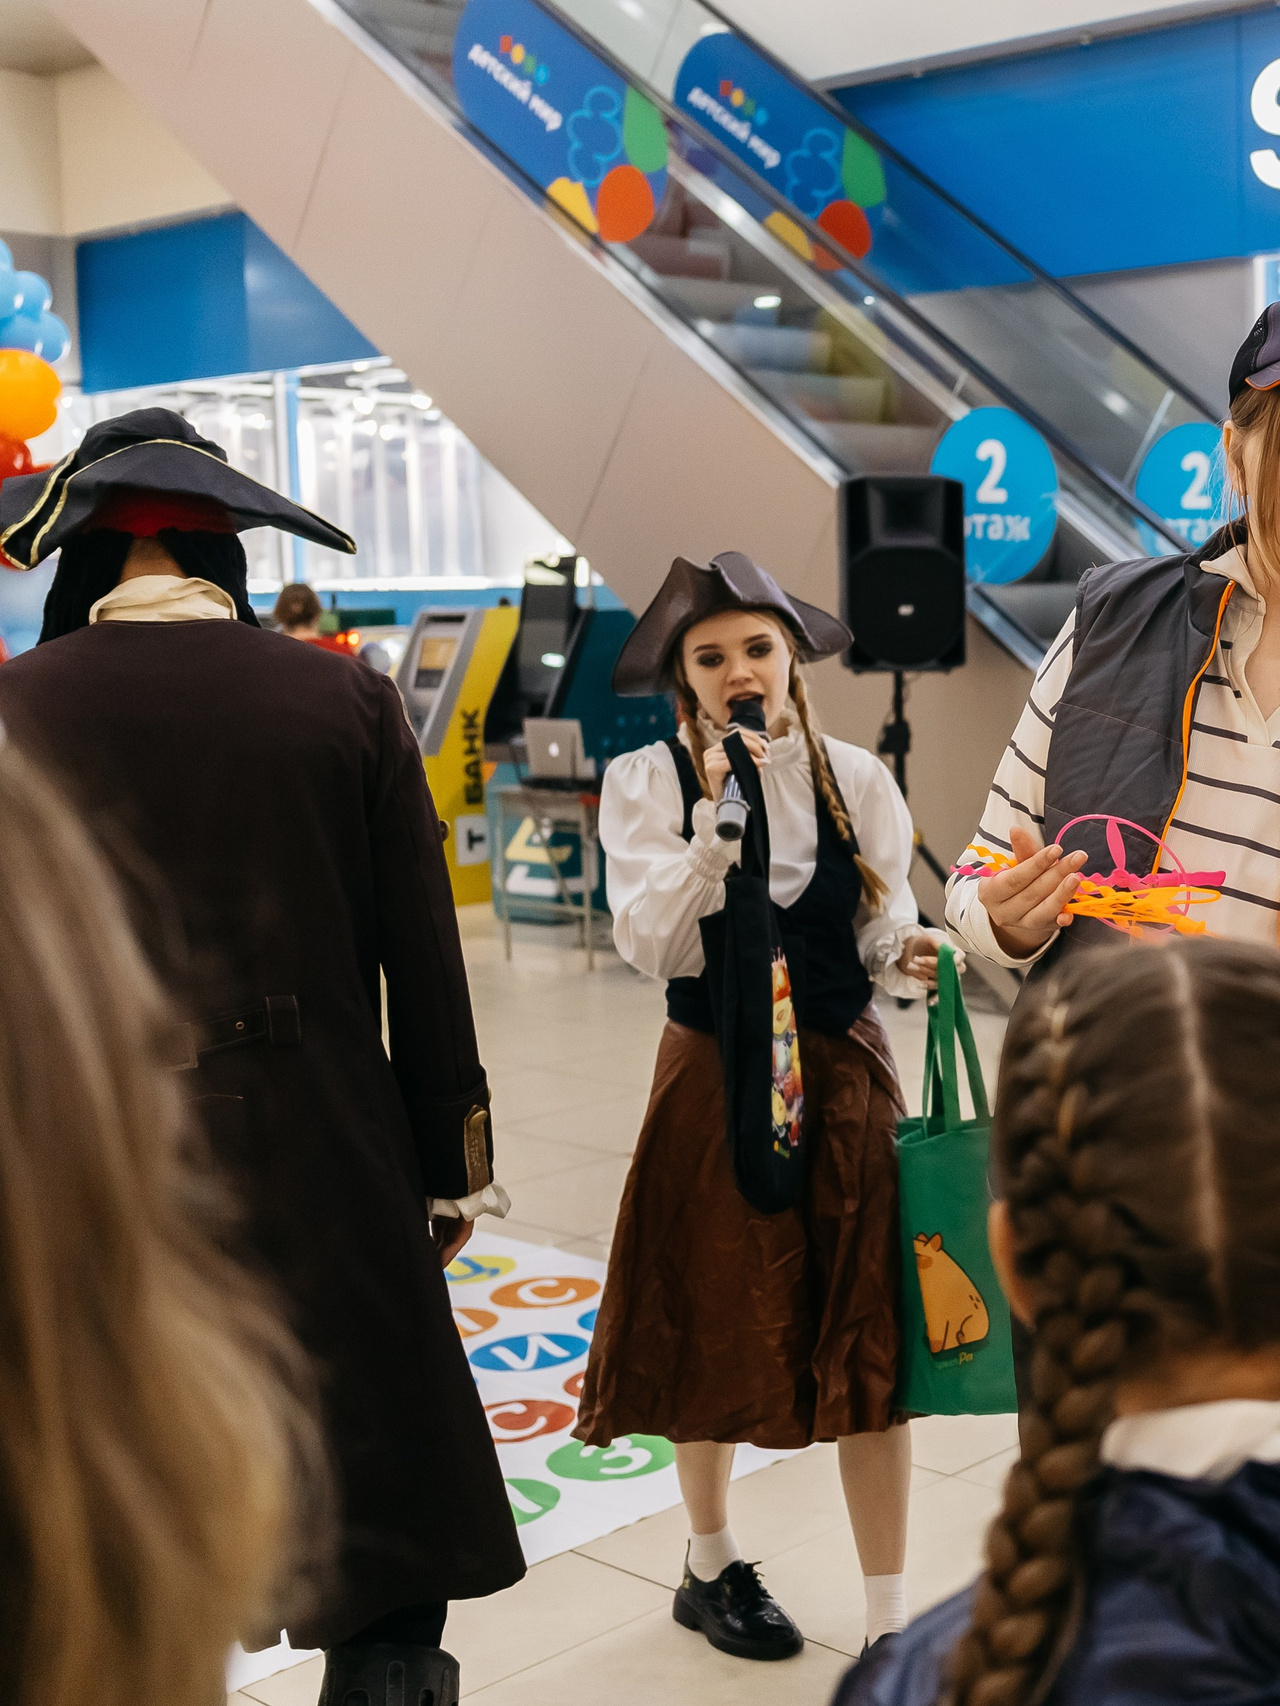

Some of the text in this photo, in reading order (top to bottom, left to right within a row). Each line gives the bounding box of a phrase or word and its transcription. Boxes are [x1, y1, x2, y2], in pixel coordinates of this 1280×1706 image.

[976, 438, 1008, 504] 2
[1180, 451, 1213, 510] 2
[461, 710, 483, 804] БАНК
